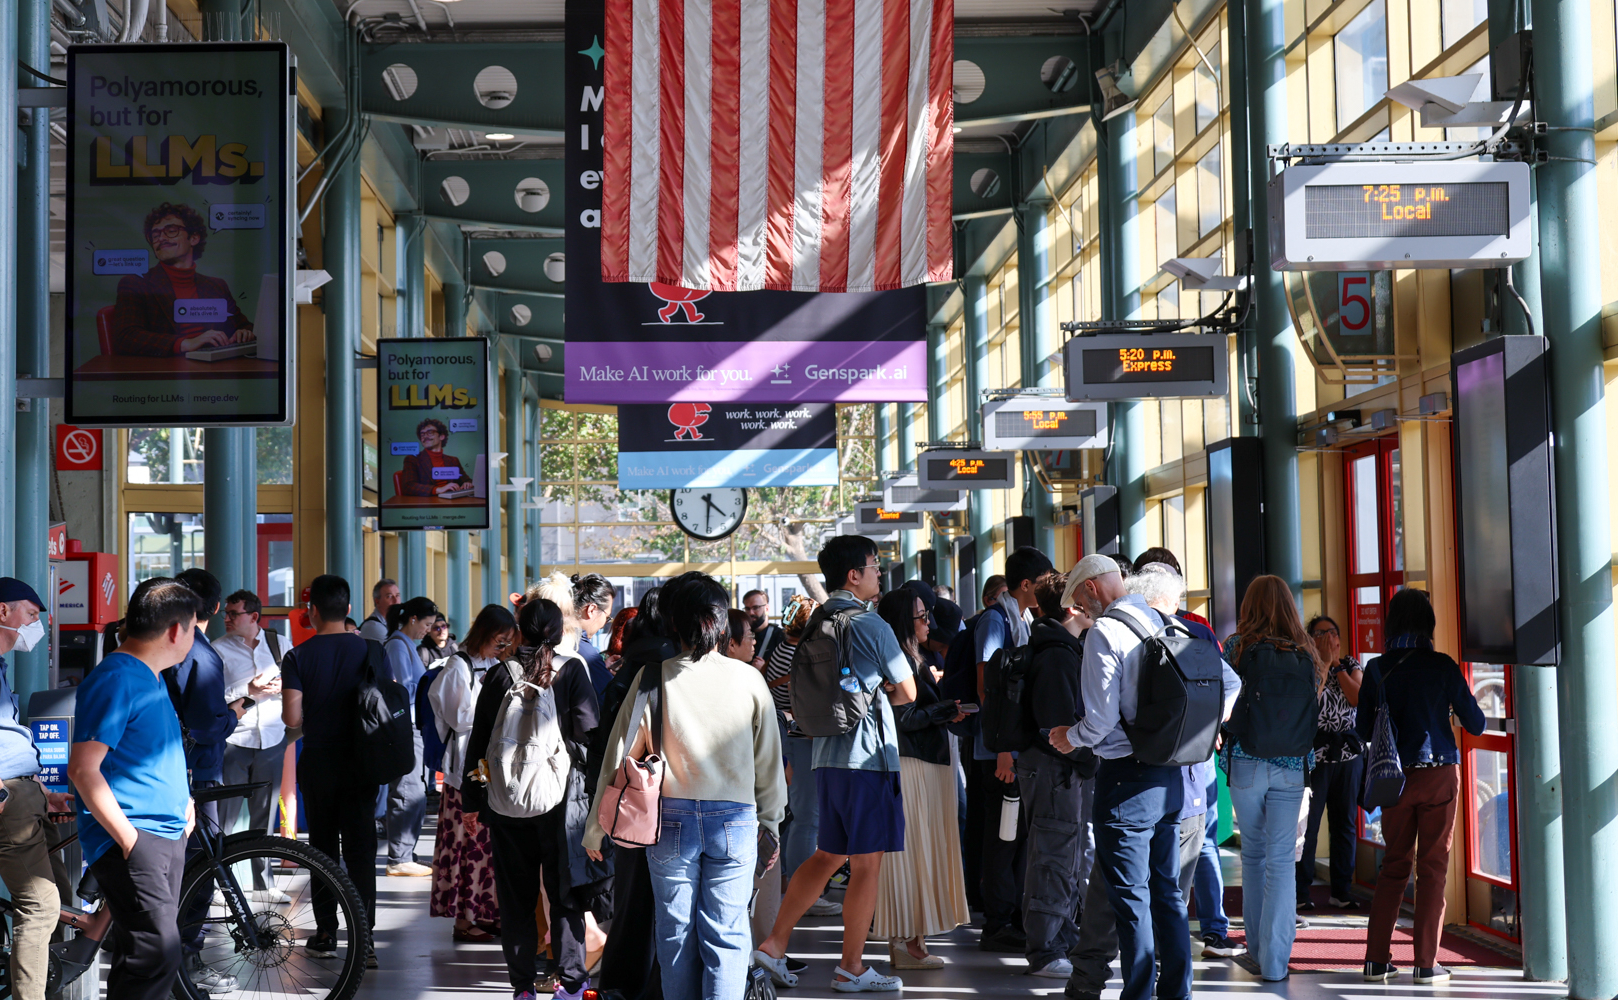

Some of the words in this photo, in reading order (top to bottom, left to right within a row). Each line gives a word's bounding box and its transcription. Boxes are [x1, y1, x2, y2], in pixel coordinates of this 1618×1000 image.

[90, 76, 263, 102] Polyamorous,
[90, 105, 132, 126] but
[137, 104, 172, 126] for
[90, 134, 265, 186] LLMs.
[1362, 184, 1400, 203] 7:25
[1414, 188, 1450, 202] p.m.
[1382, 202, 1431, 220] Local
[1340, 277, 1370, 330] 5
[388, 354, 476, 368] Polyamorous,
[1120, 348, 1144, 361] 5:20
[1153, 350, 1176, 360] p.m.
[1122, 360, 1172, 372] Express
[388, 369, 409, 380] but
[412, 369, 430, 379] for
[580, 366, 624, 382] Make
[627, 366, 649, 381] AI
[652, 365, 692, 381] work
[696, 365, 718, 381] for
[718, 368, 752, 385] you.
[804, 364, 907, 384] Genspark.ai
[112, 395, 146, 404] Routing
[193, 394, 239, 404] merge.dev
[389, 384, 478, 410] LLMs.
[725, 408, 753, 419] work.
[755, 408, 782, 419] work.
[785, 407, 812, 418] work.
[1023, 410, 1044, 420] 5:55
[1049, 411, 1068, 420] p.m.
[740, 419, 768, 430] work.
[770, 418, 798, 430] work.
[1033, 419, 1059, 429] Local
[950, 459, 966, 467] 4:25
[627, 466, 655, 476] Make
[656, 466, 669, 476] AI
[671, 465, 695, 476] work
[698, 465, 710, 475] for
[712, 466, 733, 478] you.
[763, 463, 826, 475] Genspark.ai
[957, 466, 978, 474] Local
[681, 512, 688, 520] 8
